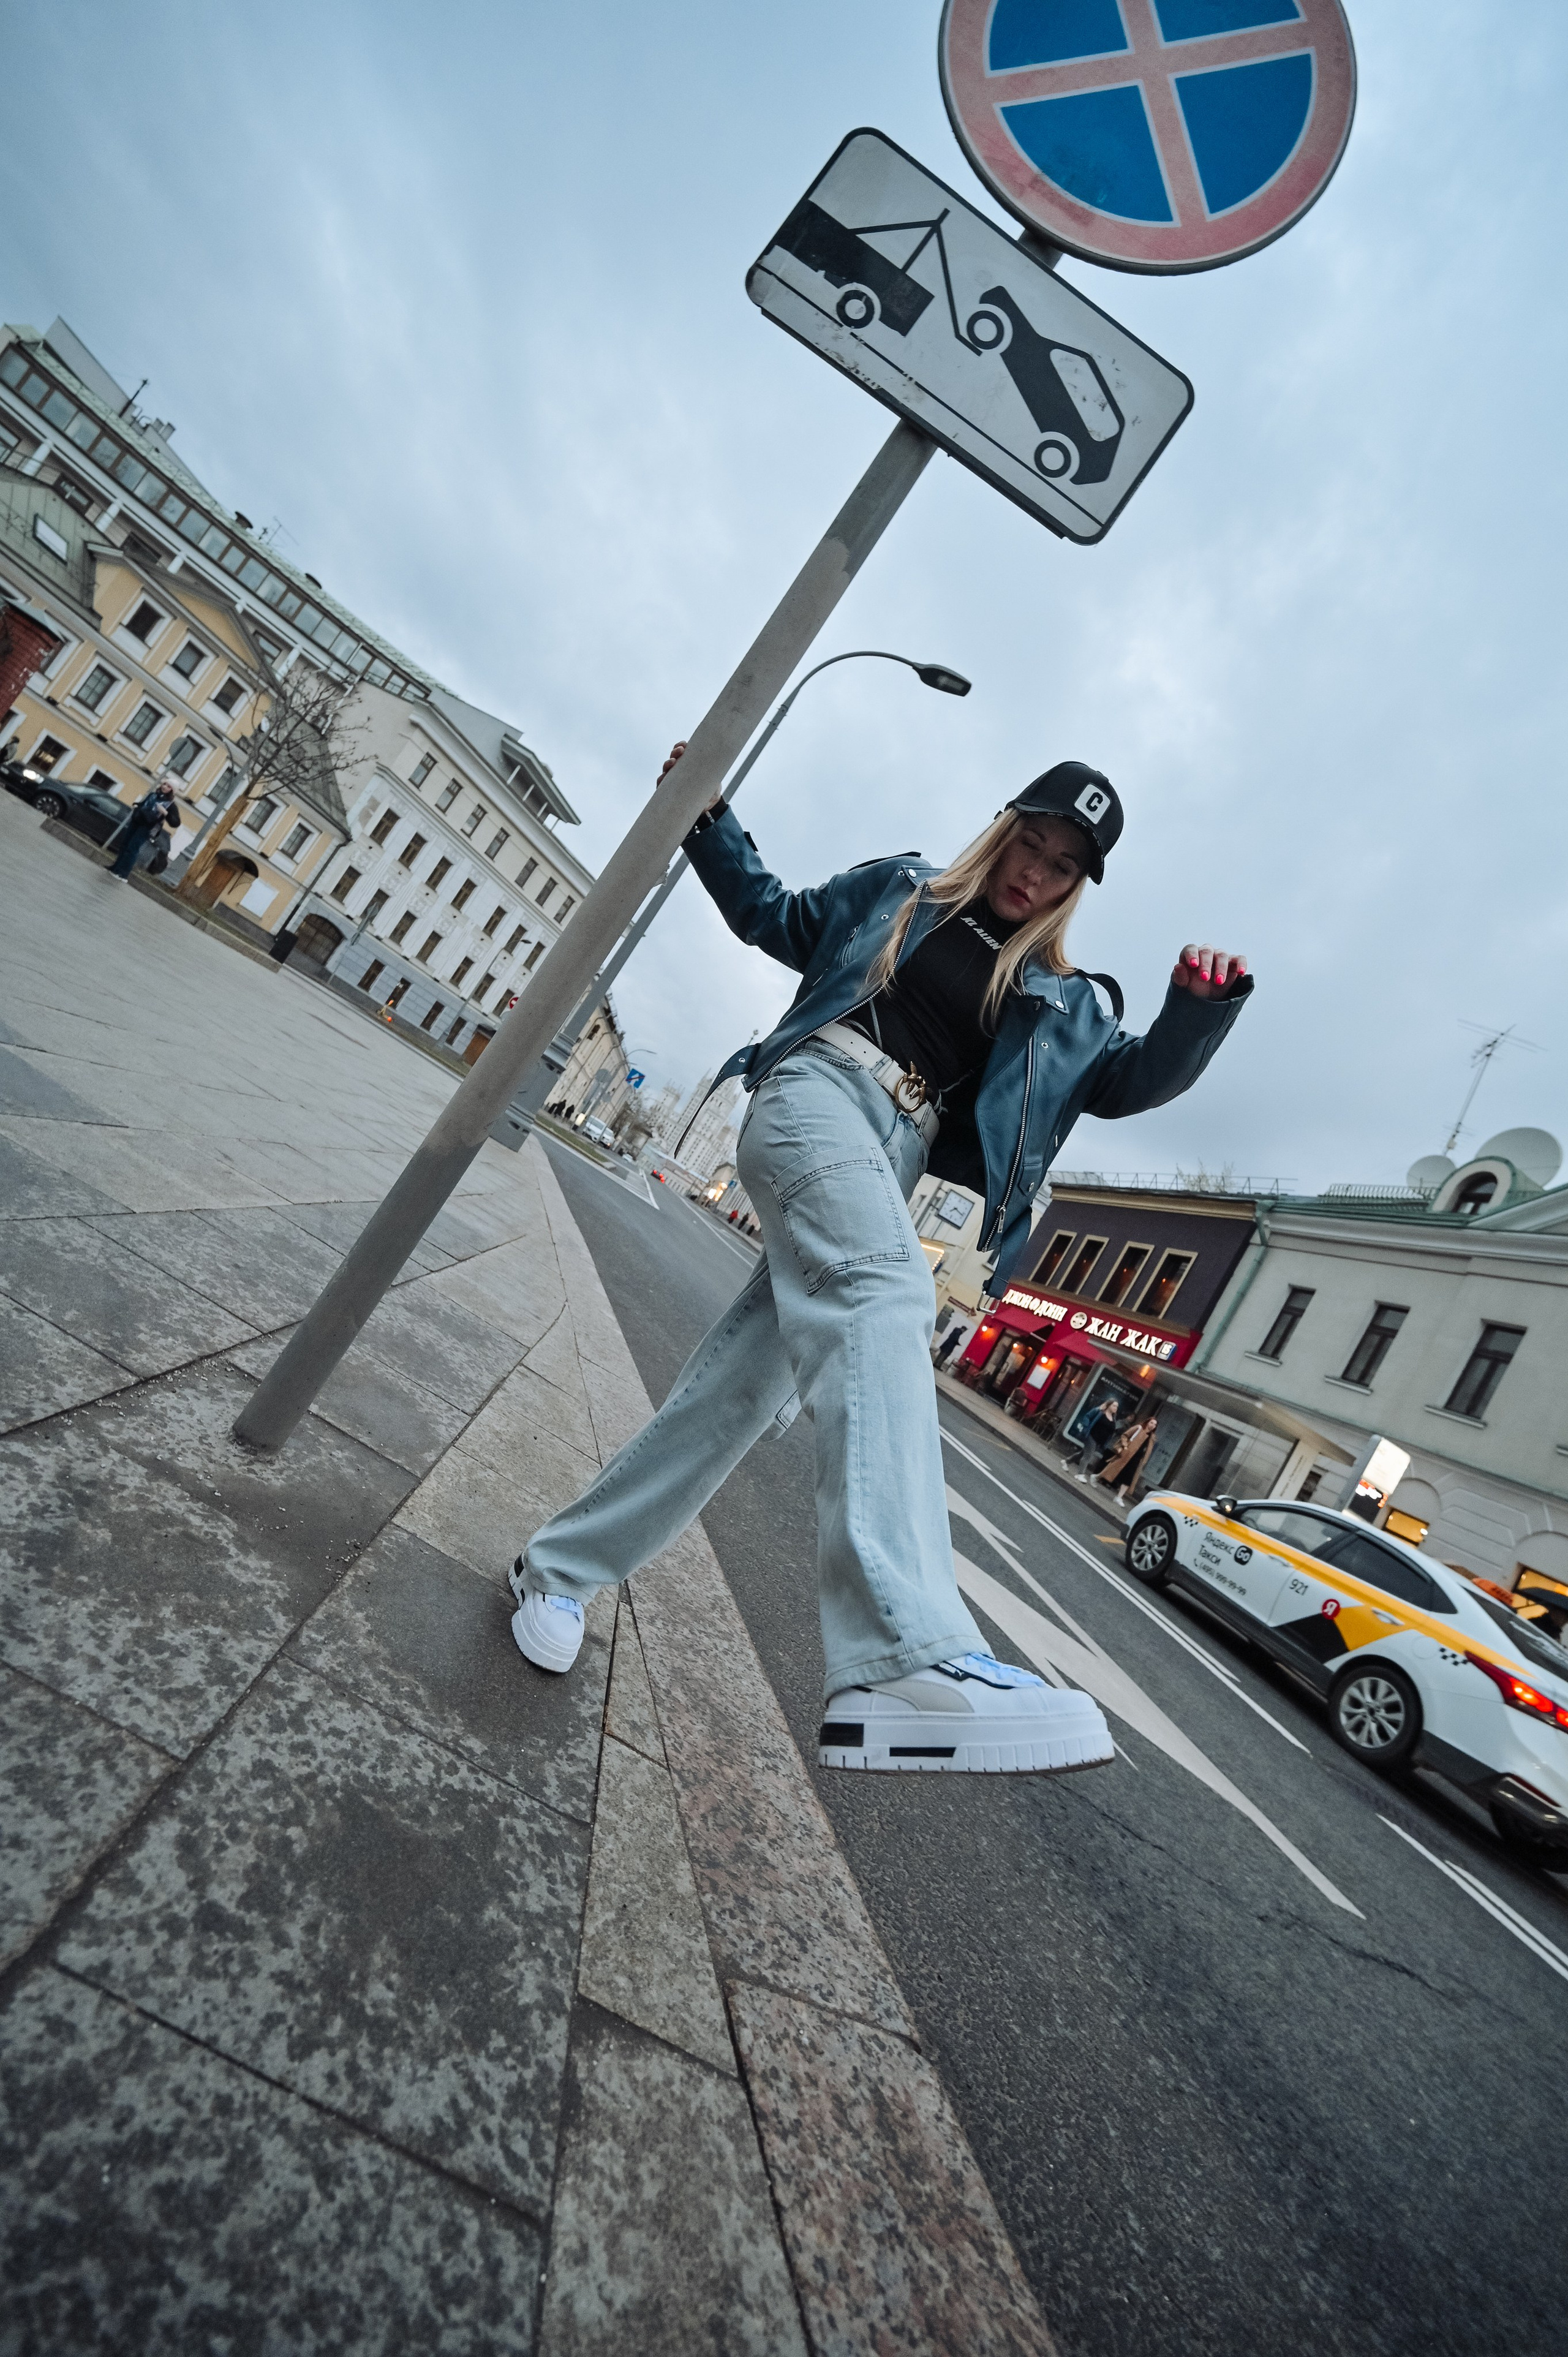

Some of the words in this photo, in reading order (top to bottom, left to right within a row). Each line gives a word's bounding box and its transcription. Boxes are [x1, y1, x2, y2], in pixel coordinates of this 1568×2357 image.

[1086, 792, 1103, 812] C
[973, 927, 1003, 950] ALIEN
[1001, 1289, 1033, 1309] ДЖОН
[1034, 1300, 1068, 1322] ДОНН
[1084, 1316, 1123, 1342] ЖАН
[1120, 1328, 1163, 1357] ЖАК
[1204, 1532, 1234, 1555] Яндекс
[1235, 1547, 1251, 1562] Go
[1199, 1544, 1221, 1566] Такси
[1289, 1579, 1309, 1596] 921
[1322, 1601, 1338, 1616] Я
